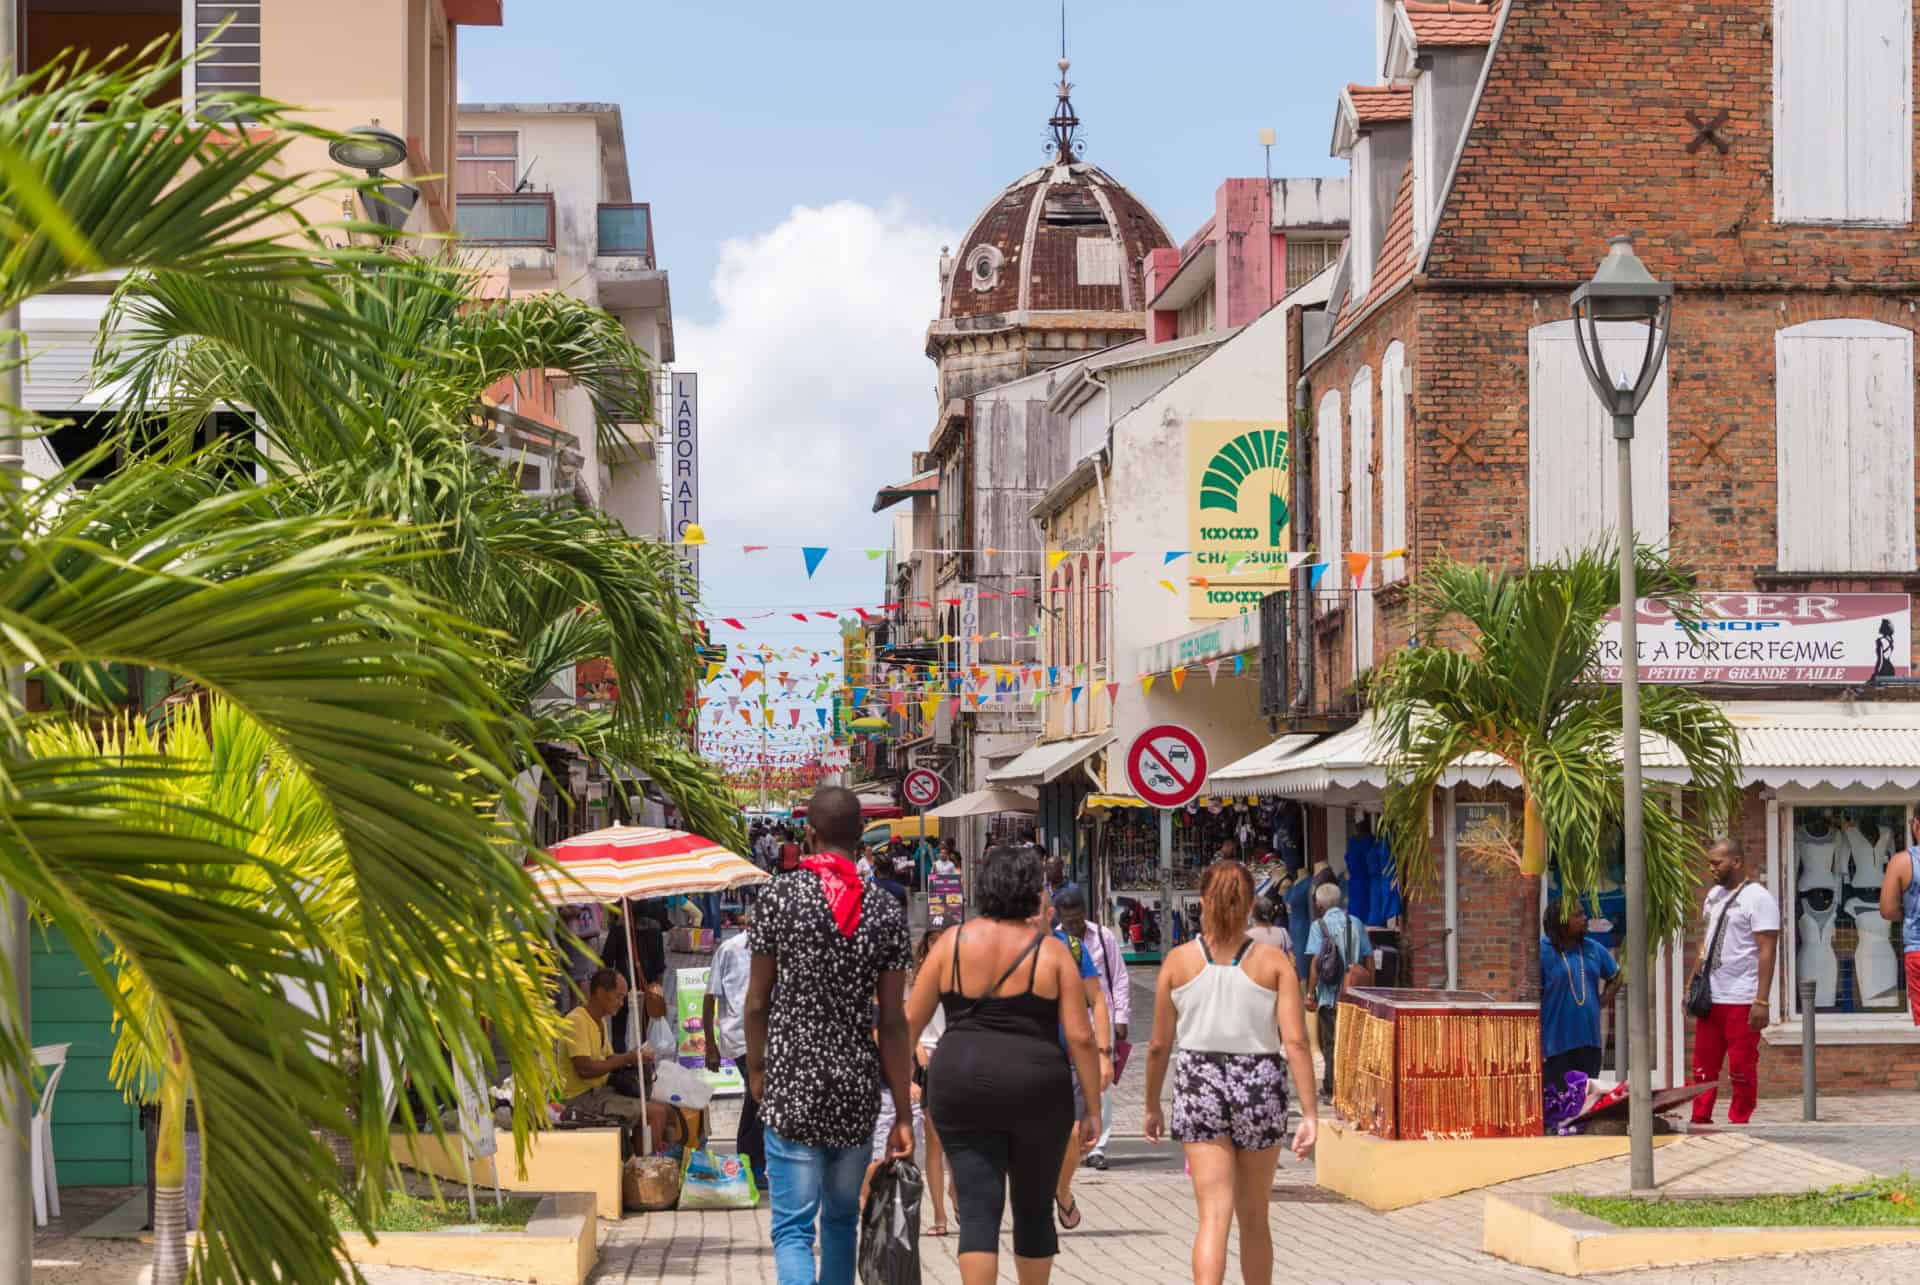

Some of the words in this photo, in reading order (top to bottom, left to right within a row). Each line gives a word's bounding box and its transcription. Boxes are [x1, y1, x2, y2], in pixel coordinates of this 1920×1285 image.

[1602, 596, 1846, 619] OKER
[1674, 620, 1780, 632] SHOP
[1652, 640, 1669, 662] A
[1675, 640, 1765, 662] PORTER
[1767, 640, 1846, 663] FEMME
[1647, 667, 1698, 680] PETITE
[1703, 667, 1725, 680] ET
[1728, 667, 1790, 681] GRANDE
[1794, 667, 1846, 681] TAILLE
